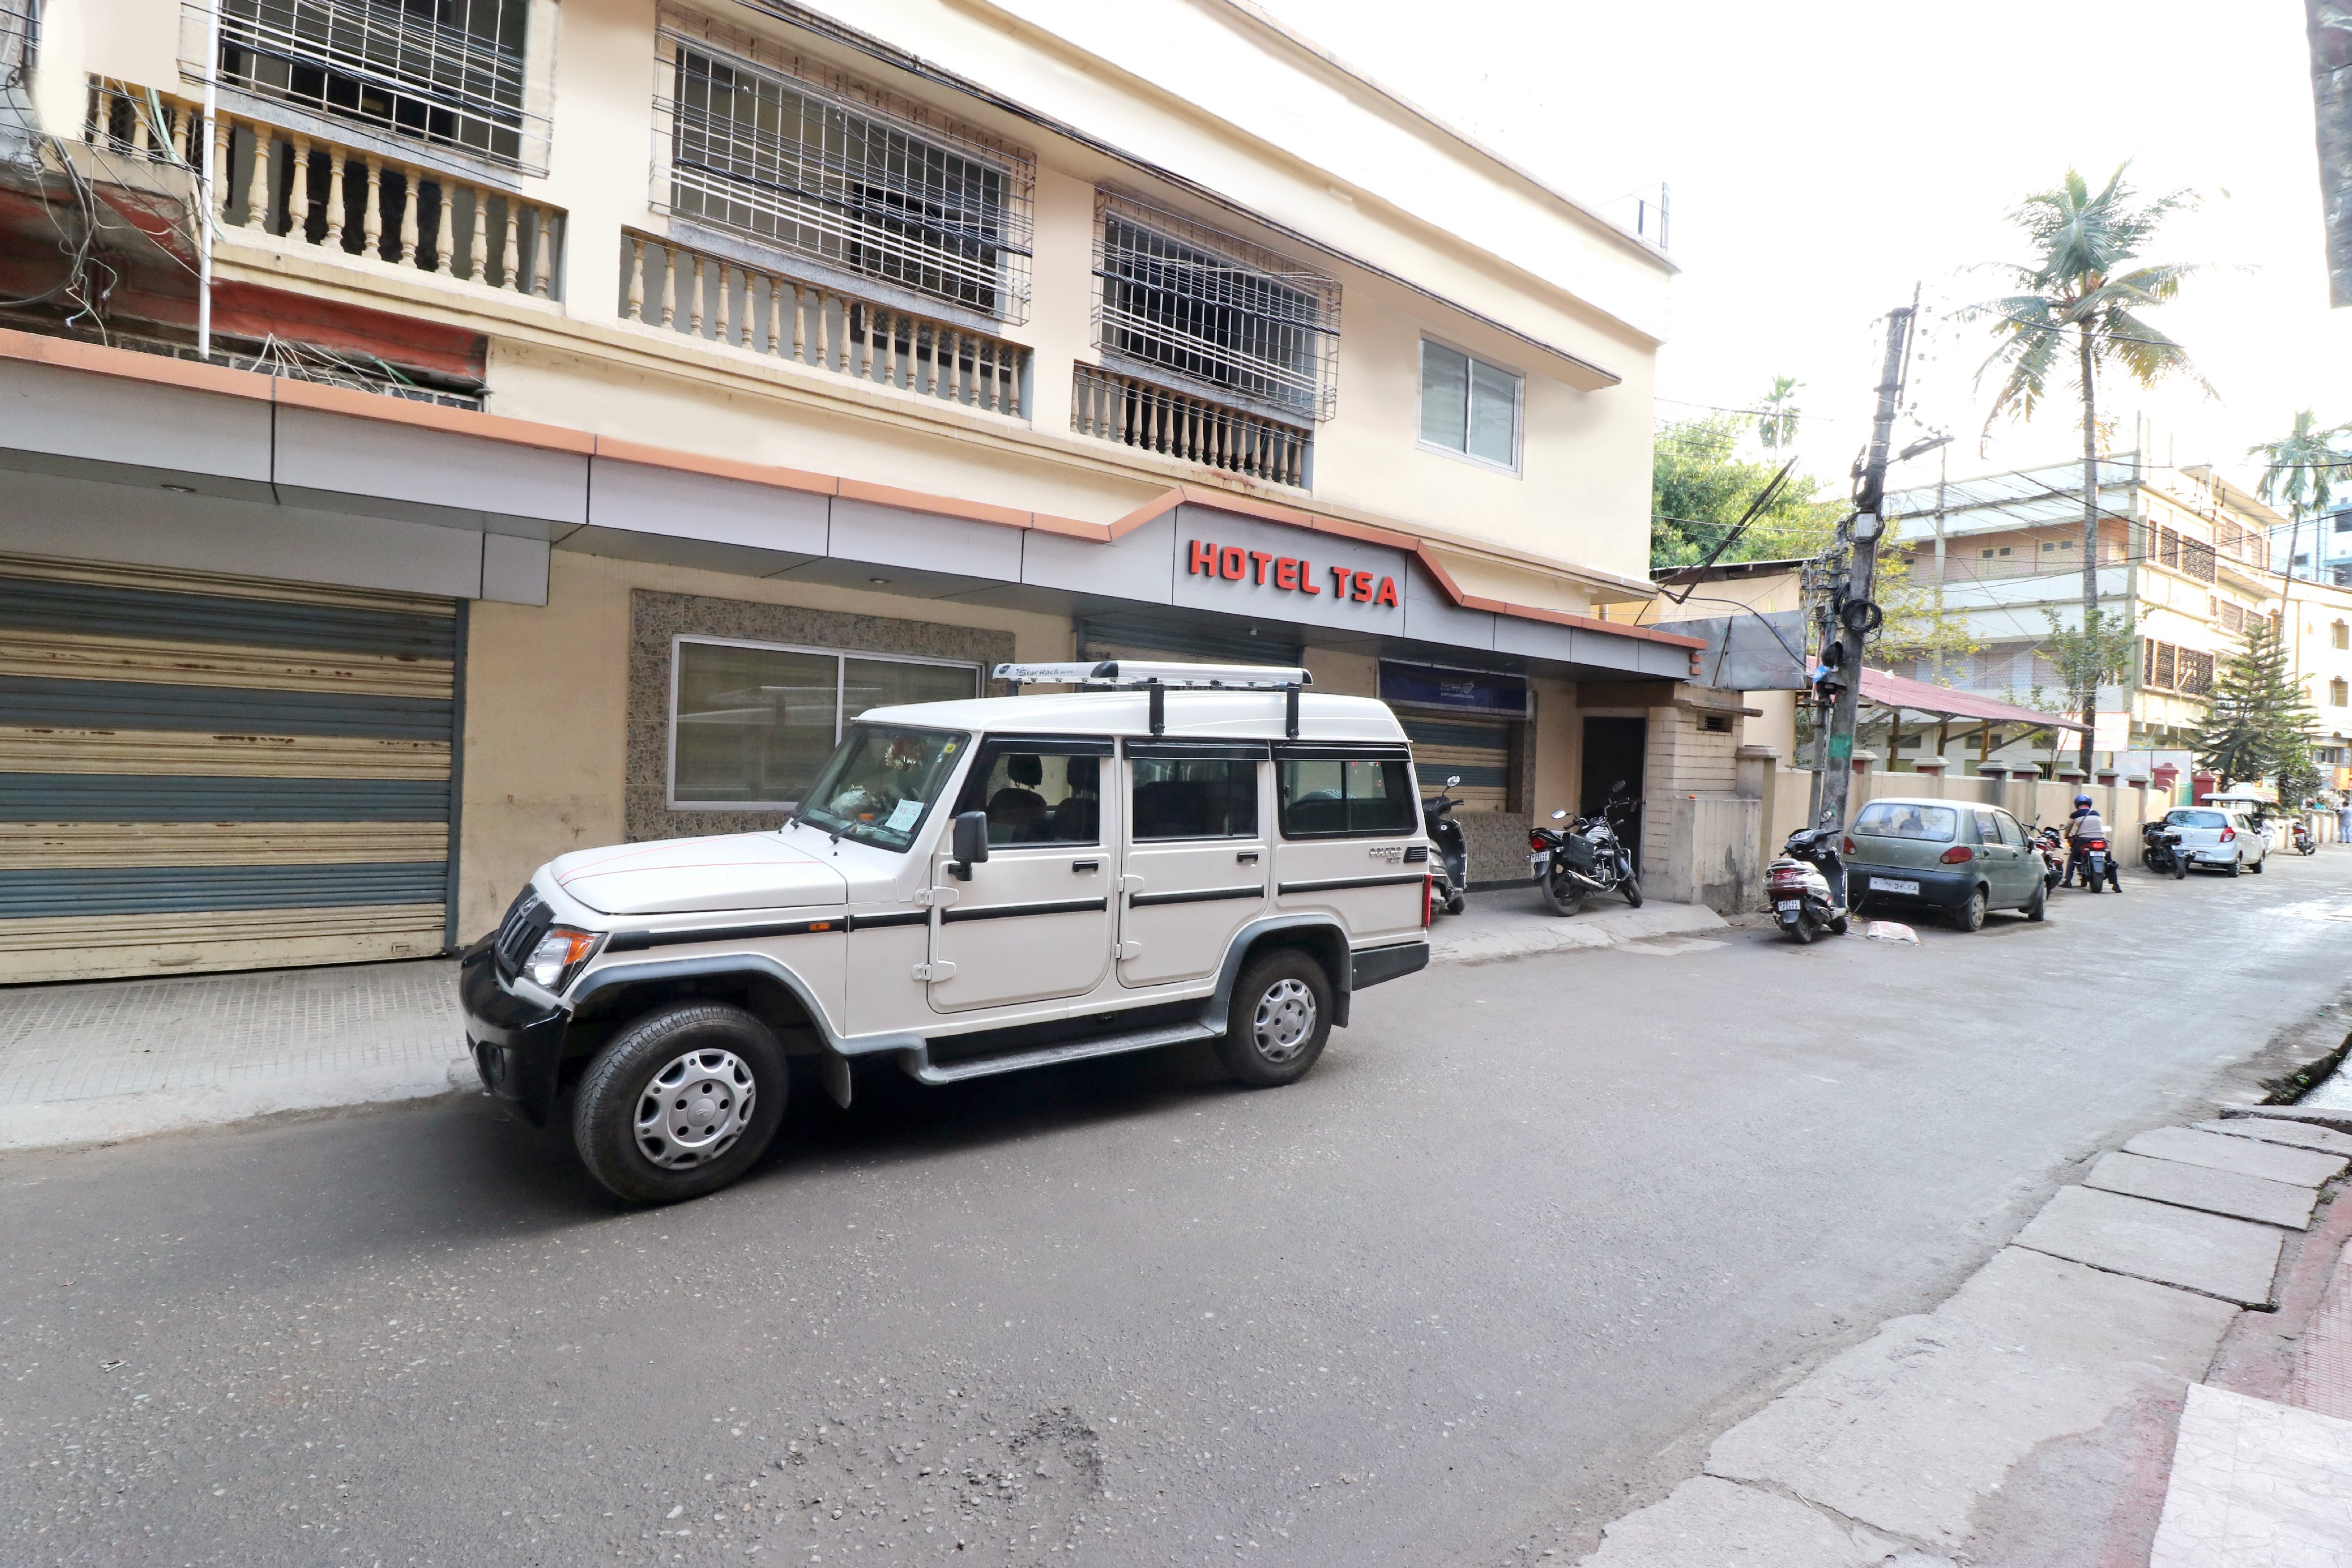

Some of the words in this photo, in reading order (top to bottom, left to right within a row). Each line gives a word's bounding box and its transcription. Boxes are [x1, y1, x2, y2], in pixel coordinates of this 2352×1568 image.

[1188, 539, 1321, 595] HOTEL
[1330, 566, 1399, 608] TSA
[1016, 666, 1039, 676] Star
